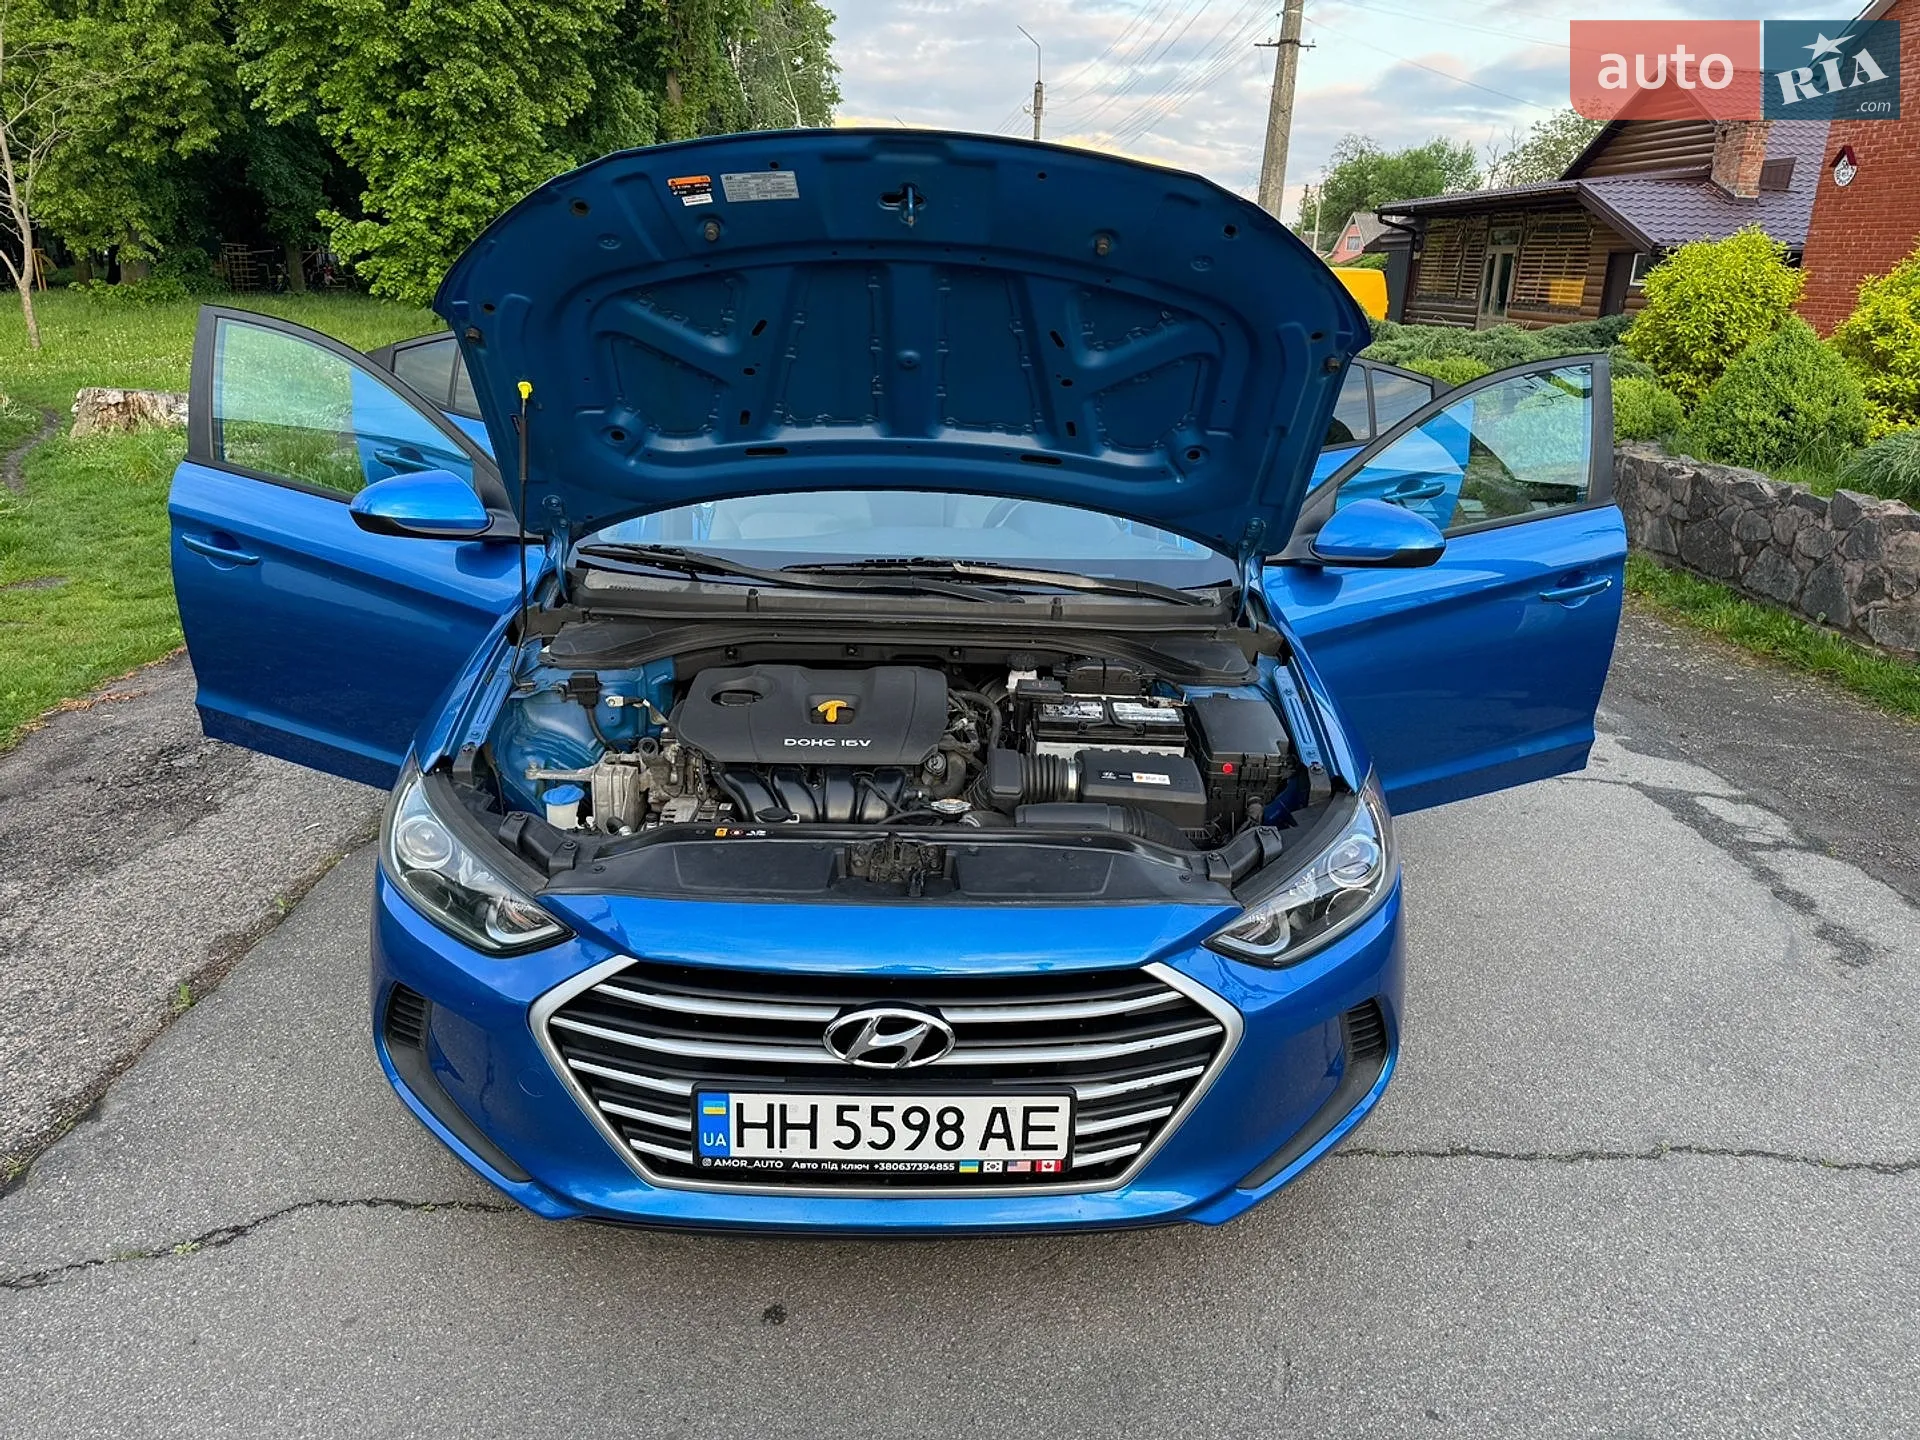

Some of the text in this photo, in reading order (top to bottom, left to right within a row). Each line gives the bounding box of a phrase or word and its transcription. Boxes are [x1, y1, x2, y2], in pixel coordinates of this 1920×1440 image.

[783, 738, 871, 747] DOHC 16V
[736, 1103, 1060, 1151] HH 5598 AE
[703, 1133, 727, 1147] UA
[714, 1159, 784, 1169] AMOR_AUTO
[791, 1162, 819, 1170] Авто
[821, 1162, 839, 1172] під
[873, 1162, 955, 1171] +380637394855
